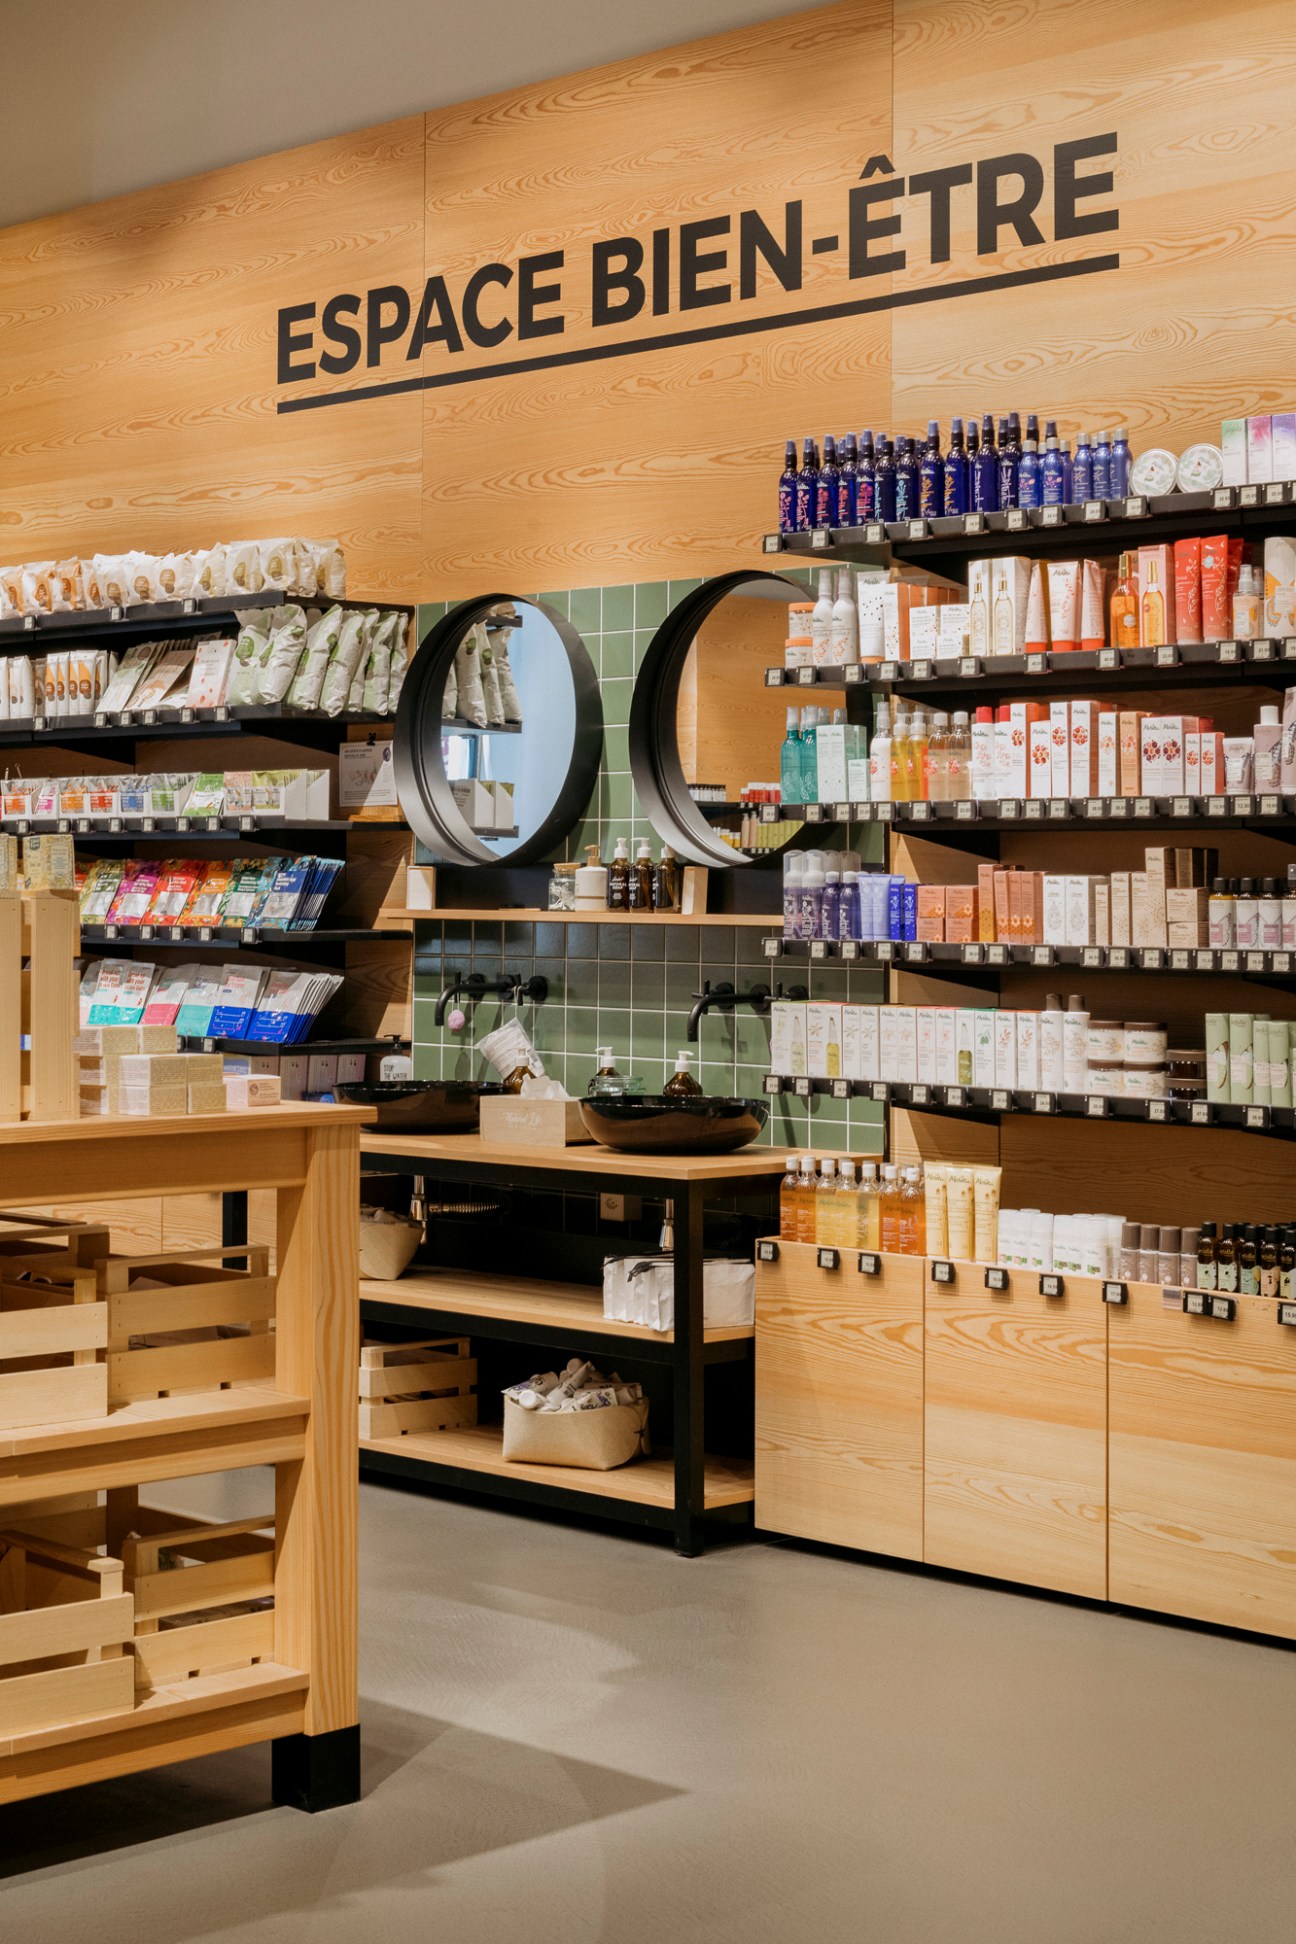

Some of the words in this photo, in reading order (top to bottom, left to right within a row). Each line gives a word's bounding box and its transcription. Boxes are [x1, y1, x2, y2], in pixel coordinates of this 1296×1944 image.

[277, 250, 564, 385] ESPACE
[592, 131, 1119, 328] BIEN-ÊTRE
[383, 1064, 394, 1072] STOP
